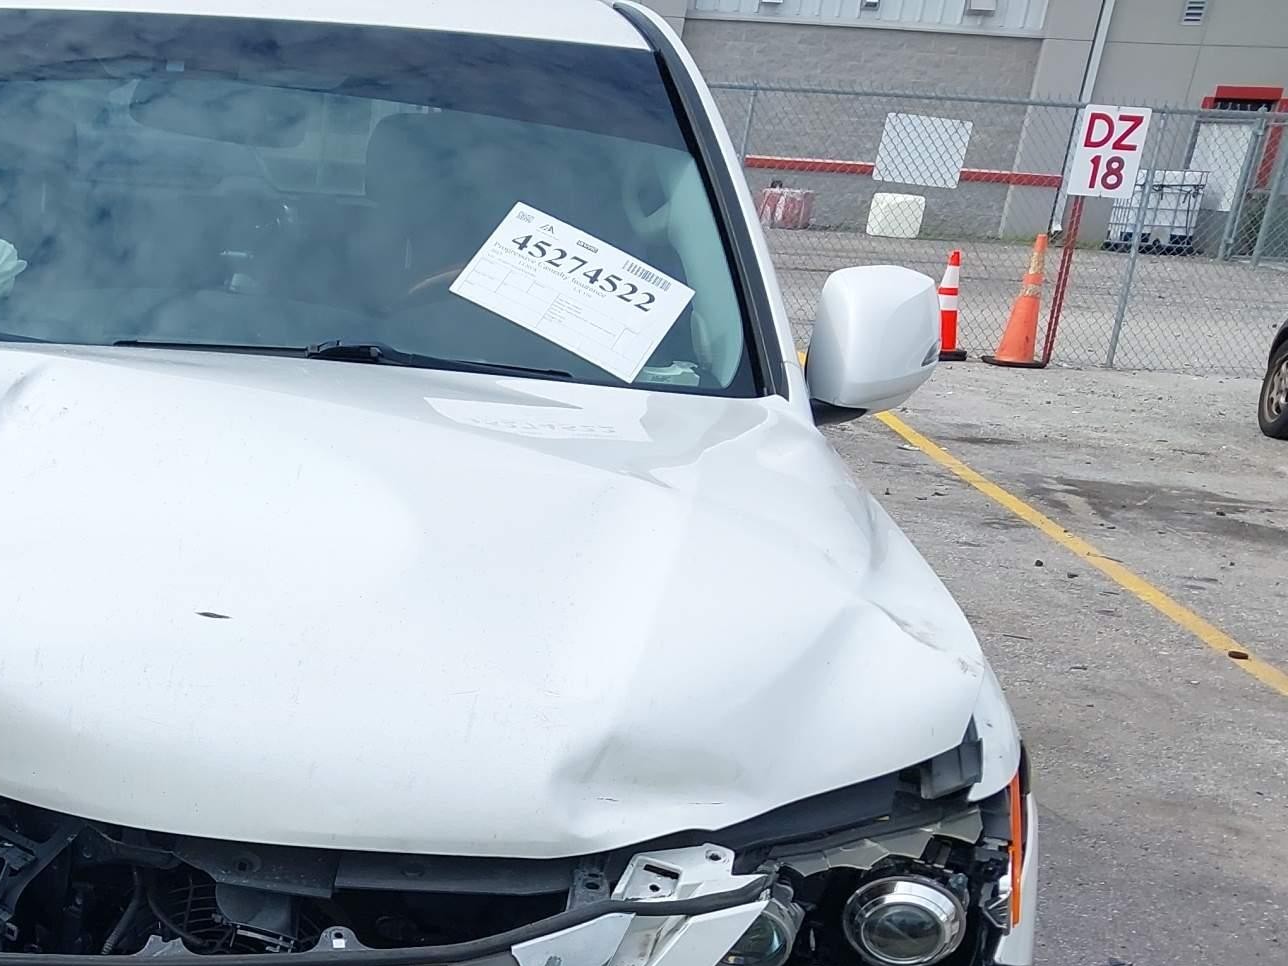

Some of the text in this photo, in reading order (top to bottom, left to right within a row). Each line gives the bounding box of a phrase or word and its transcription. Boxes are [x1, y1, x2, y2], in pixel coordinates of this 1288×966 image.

[1084, 113, 1144, 151] DZ
[1088, 155, 1125, 190] 18
[511, 234, 657, 312] 45274522
